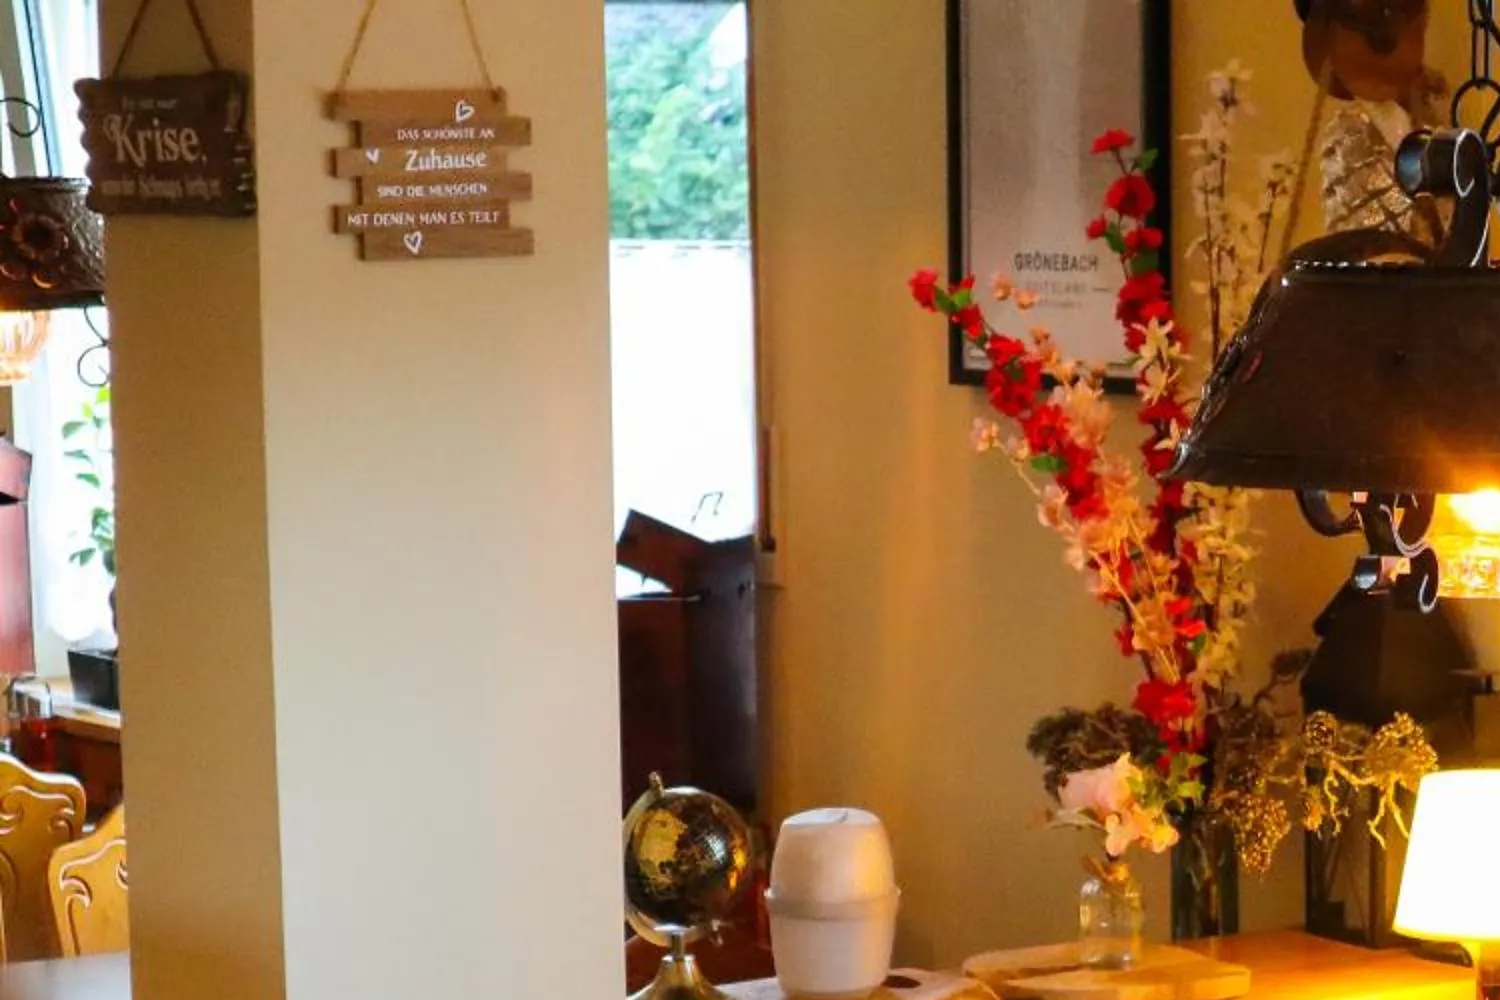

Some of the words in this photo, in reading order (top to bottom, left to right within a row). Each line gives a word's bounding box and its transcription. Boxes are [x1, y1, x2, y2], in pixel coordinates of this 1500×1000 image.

[397, 128, 419, 141] DAS
[479, 127, 495, 139] AN
[404, 148, 487, 171] Zuhause
[377, 185, 403, 198] SIND
[407, 185, 425, 198] DIE
[429, 182, 487, 197] MENSCHEN
[348, 213, 368, 225] MIT
[373, 212, 415, 226] DENEN
[419, 211, 447, 225] MAN
[450, 211, 465, 224] ES
[468, 210, 499, 223] TEILT
